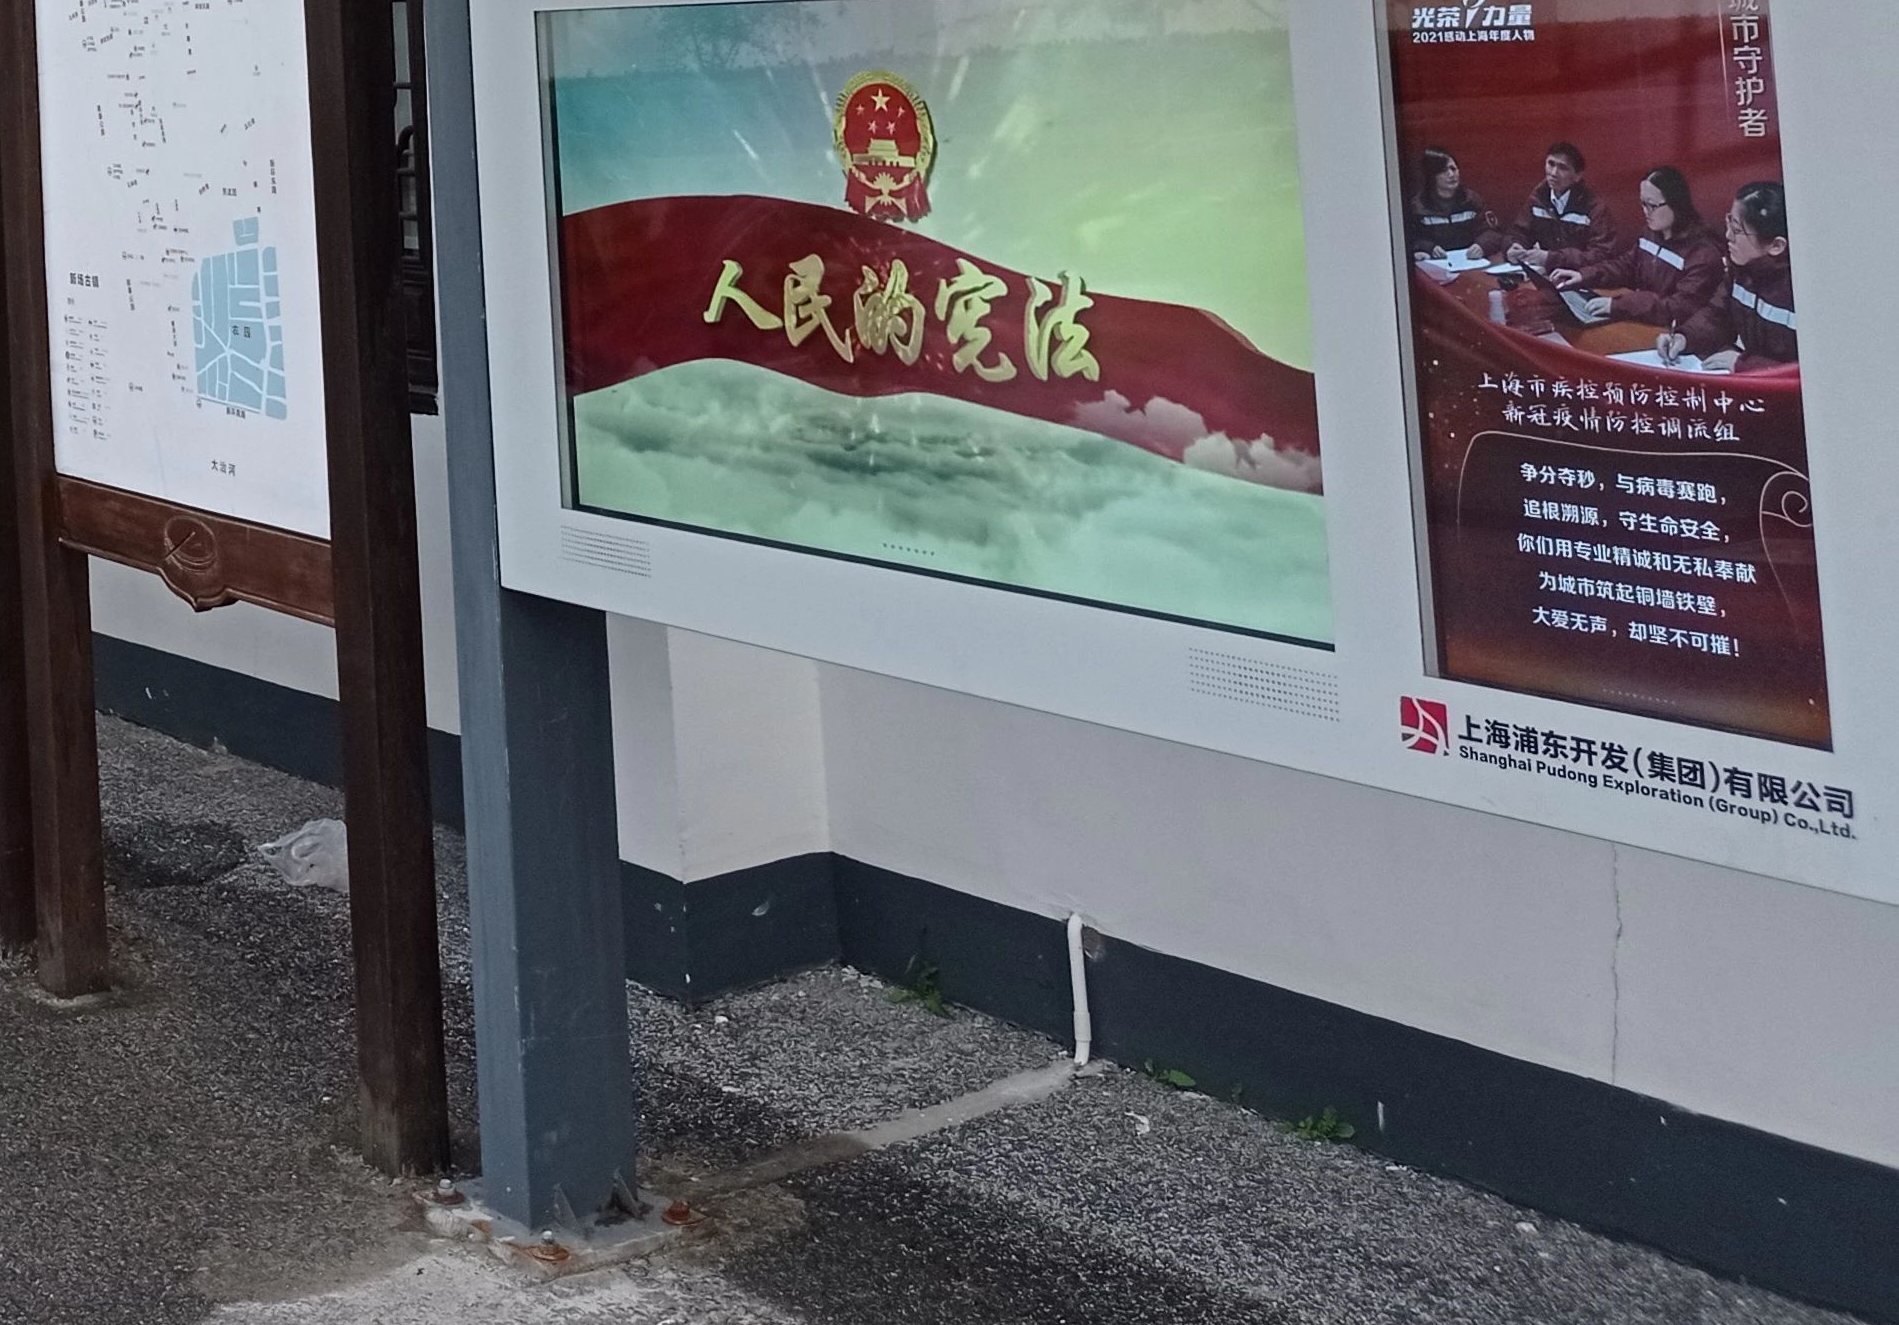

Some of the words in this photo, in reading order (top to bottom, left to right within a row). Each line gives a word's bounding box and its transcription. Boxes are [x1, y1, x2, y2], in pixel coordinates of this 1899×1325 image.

[1412, 28, 1536, 44] 2021感动上海年度人物
[703, 252, 1102, 384] 人民的宪法
[1476, 371, 1766, 415] 上海市疾控预防控制中心
[1519, 462, 1727, 505] 争分夺秒，与病毒赛跑，
[1522, 498, 1731, 544] 追根溯源，守生命安全，
[1516, 532, 1758, 585] 你们用专业精诚和无私奉献
[1538, 570, 1727, 617] 为城市筑起铜墙铁壁，
[1532, 605, 1741, 657] 大爱无声，却坚不可摧！
[1457, 714, 1856, 820] 上海浦东开发(集团)有限公司
[1458, 744, 1533, 775] Shanghai
[1536, 760, 1599, 789] Pudong
[1602, 774, 1705, 810] Exploration
[1708, 794, 1779, 826] (Group)
